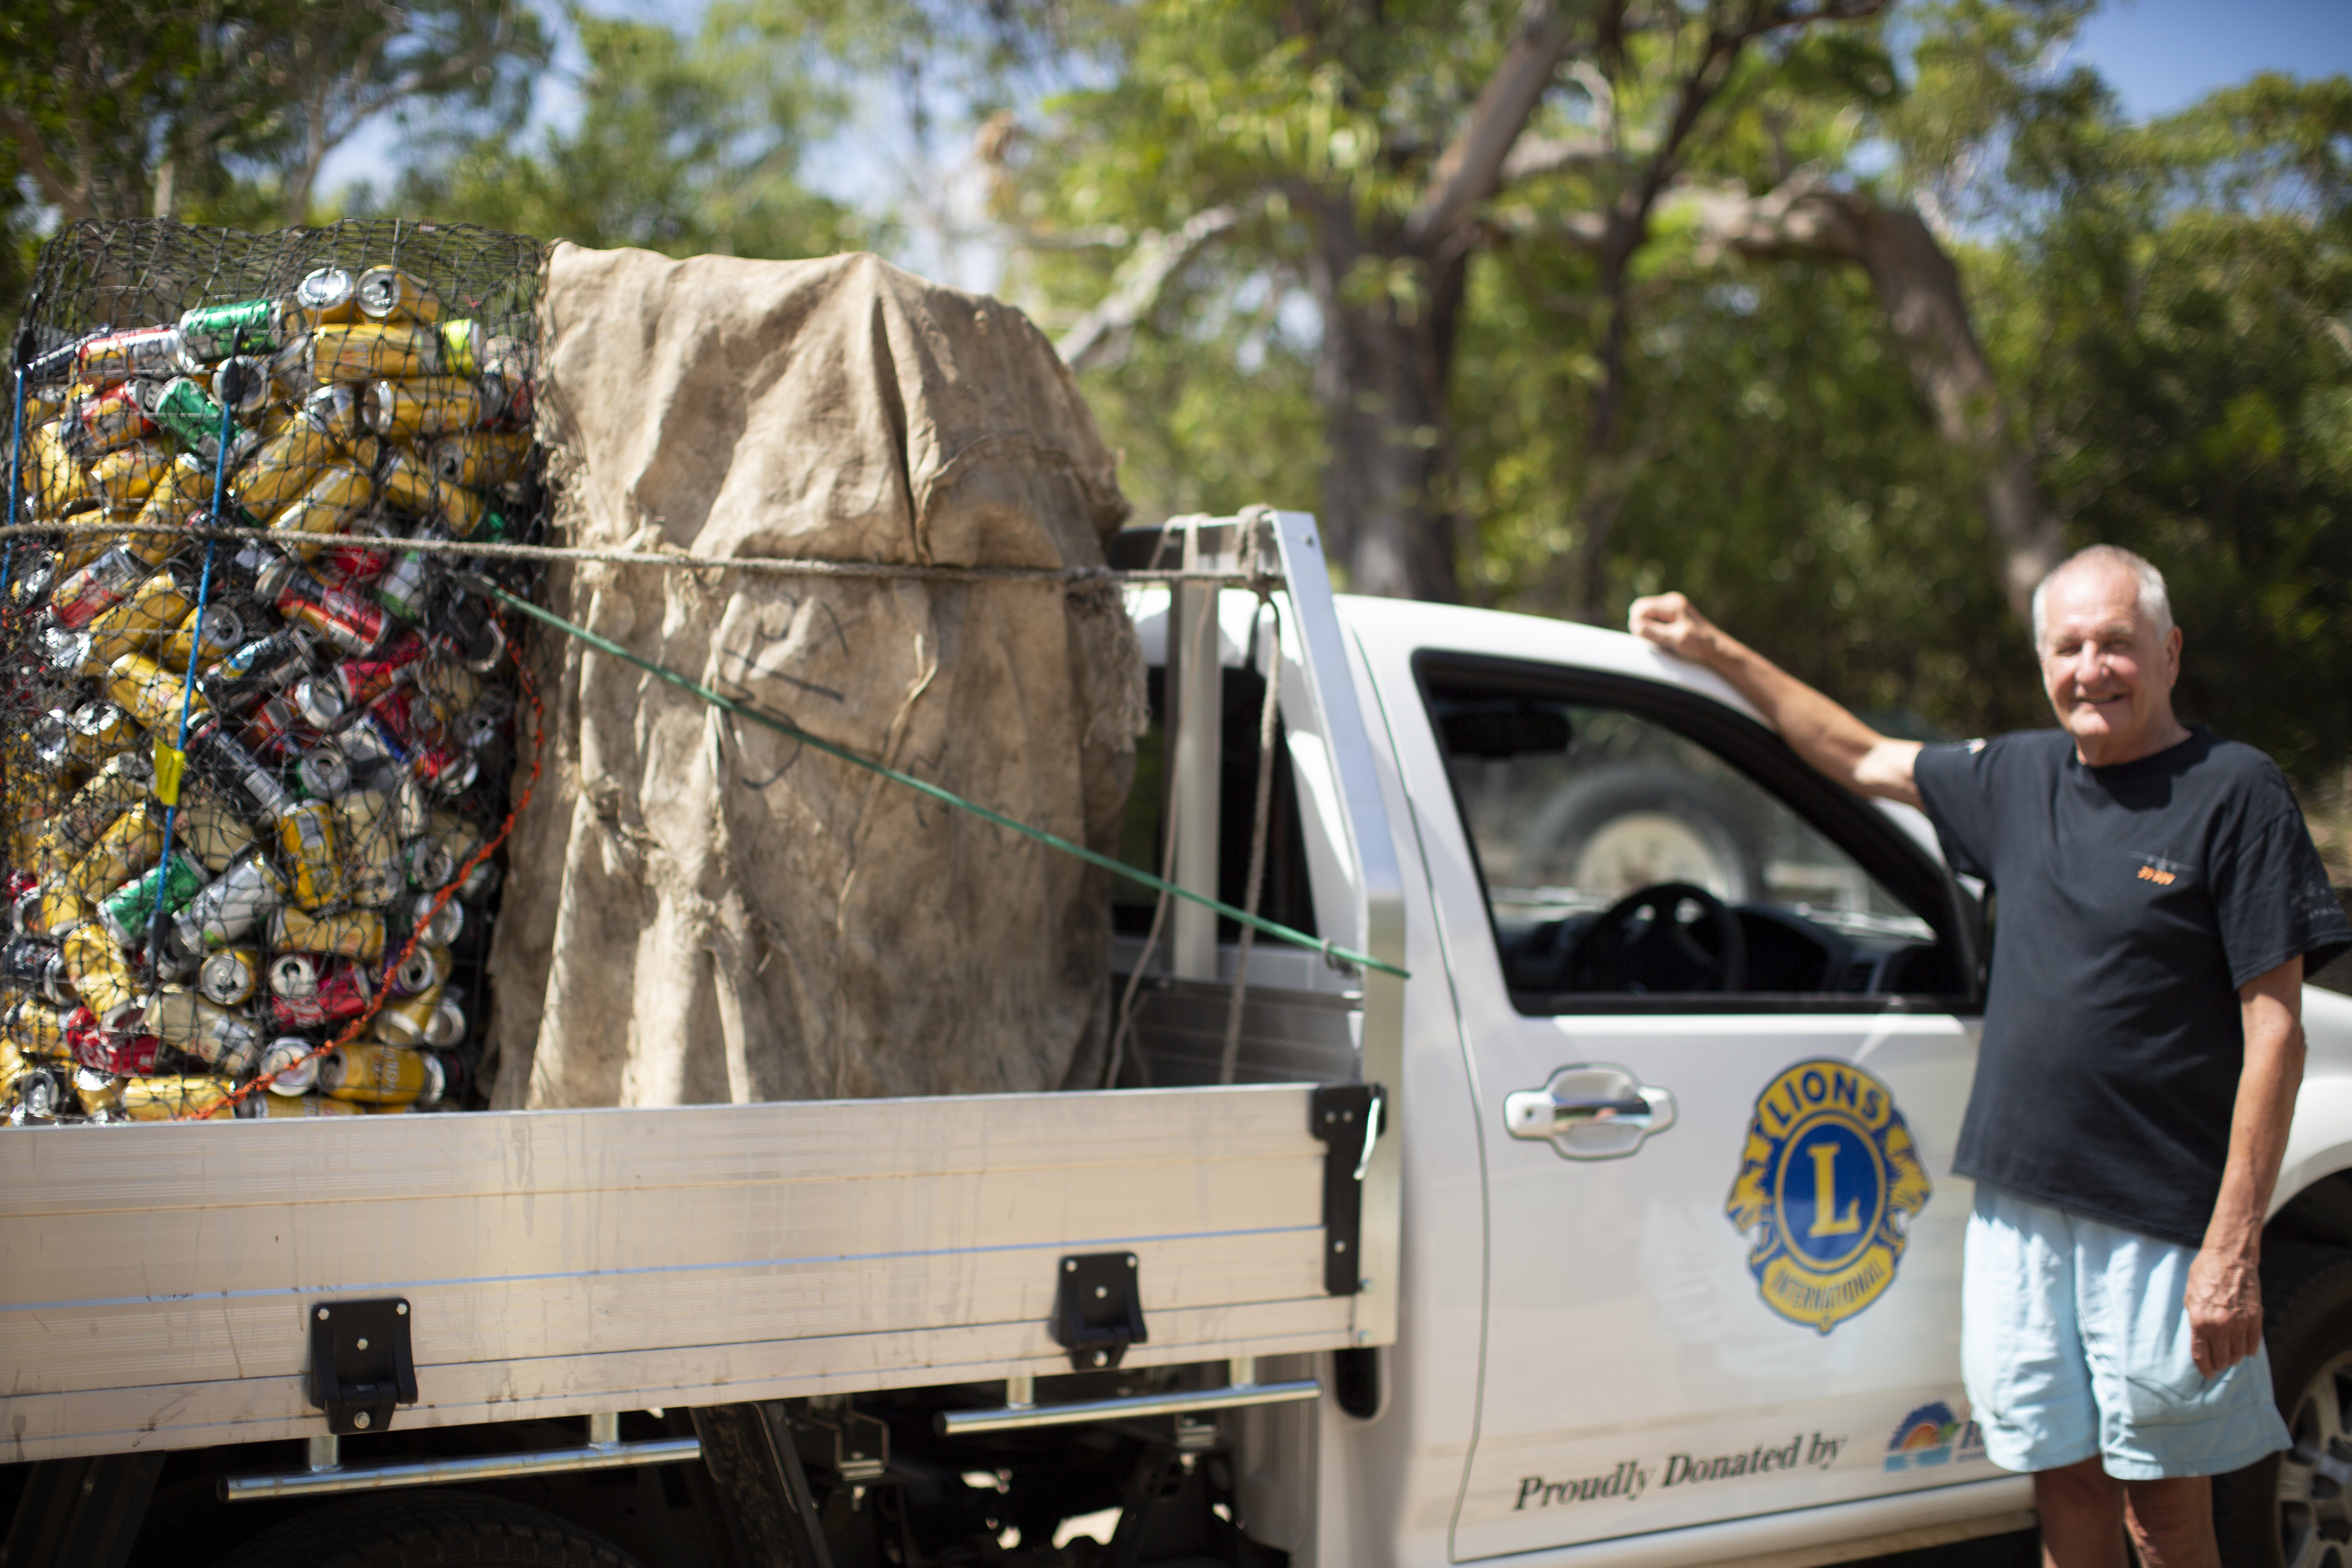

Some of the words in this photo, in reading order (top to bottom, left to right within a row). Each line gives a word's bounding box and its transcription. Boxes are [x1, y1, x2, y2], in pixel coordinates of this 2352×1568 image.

[1767, 1069, 1884, 1127] LIONS
[1808, 1143, 1860, 1236] L
[1772, 1260, 1884, 1310] INTERNATIONAL
[1513, 1459, 1656, 1511] Proudly
[1661, 1434, 1802, 1488] Donated
[1806, 1431, 1848, 1470] by
